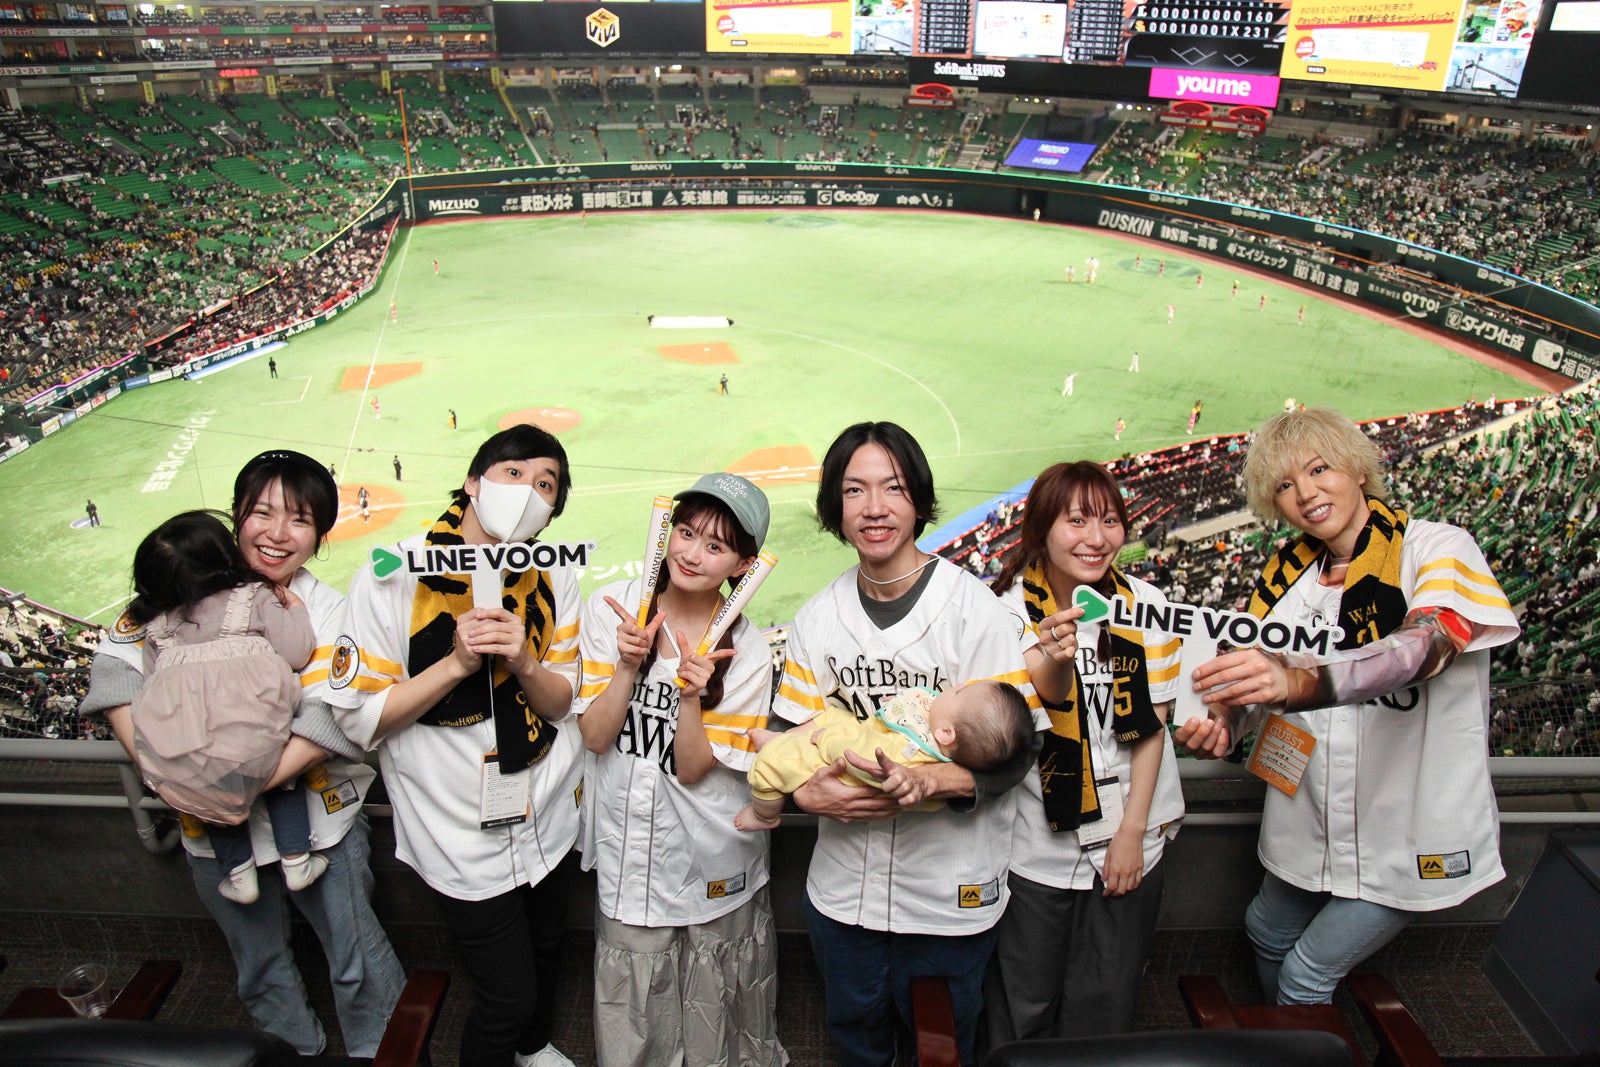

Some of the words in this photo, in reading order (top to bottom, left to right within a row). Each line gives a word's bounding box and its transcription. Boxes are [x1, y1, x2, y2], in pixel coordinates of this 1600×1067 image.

[934, 61, 973, 76] SoftBank
[972, 63, 1006, 78] HAWKS
[1176, 75, 1252, 97] youme
[631, 163, 672, 171] SANKYU
[795, 164, 836, 172] SANKYU
[428, 198, 480, 212] MIZUHO
[521, 193, 573, 212] 武田メガネ
[681, 190, 728, 206] 英進館
[833, 190, 880, 206] GooDay
[1098, 209, 1155, 238] DUSKIN
[1236, 245, 1289, 269] エイジェック
[1293, 264, 1360, 297] 昭和建設
[1402, 290, 1440, 313] OTTO!
[1461, 314, 1526, 352] ダイワ化成
[1561, 357, 1600, 383] 福岡
[407, 548, 477, 573] LINE
[1112, 599, 1194, 636] LINE
[827, 654, 948, 694] SoftBank
[1113, 676, 1133, 717] 5
[459, 711, 484, 726] HAWKS
[1269, 725, 1305, 750] GUEST
